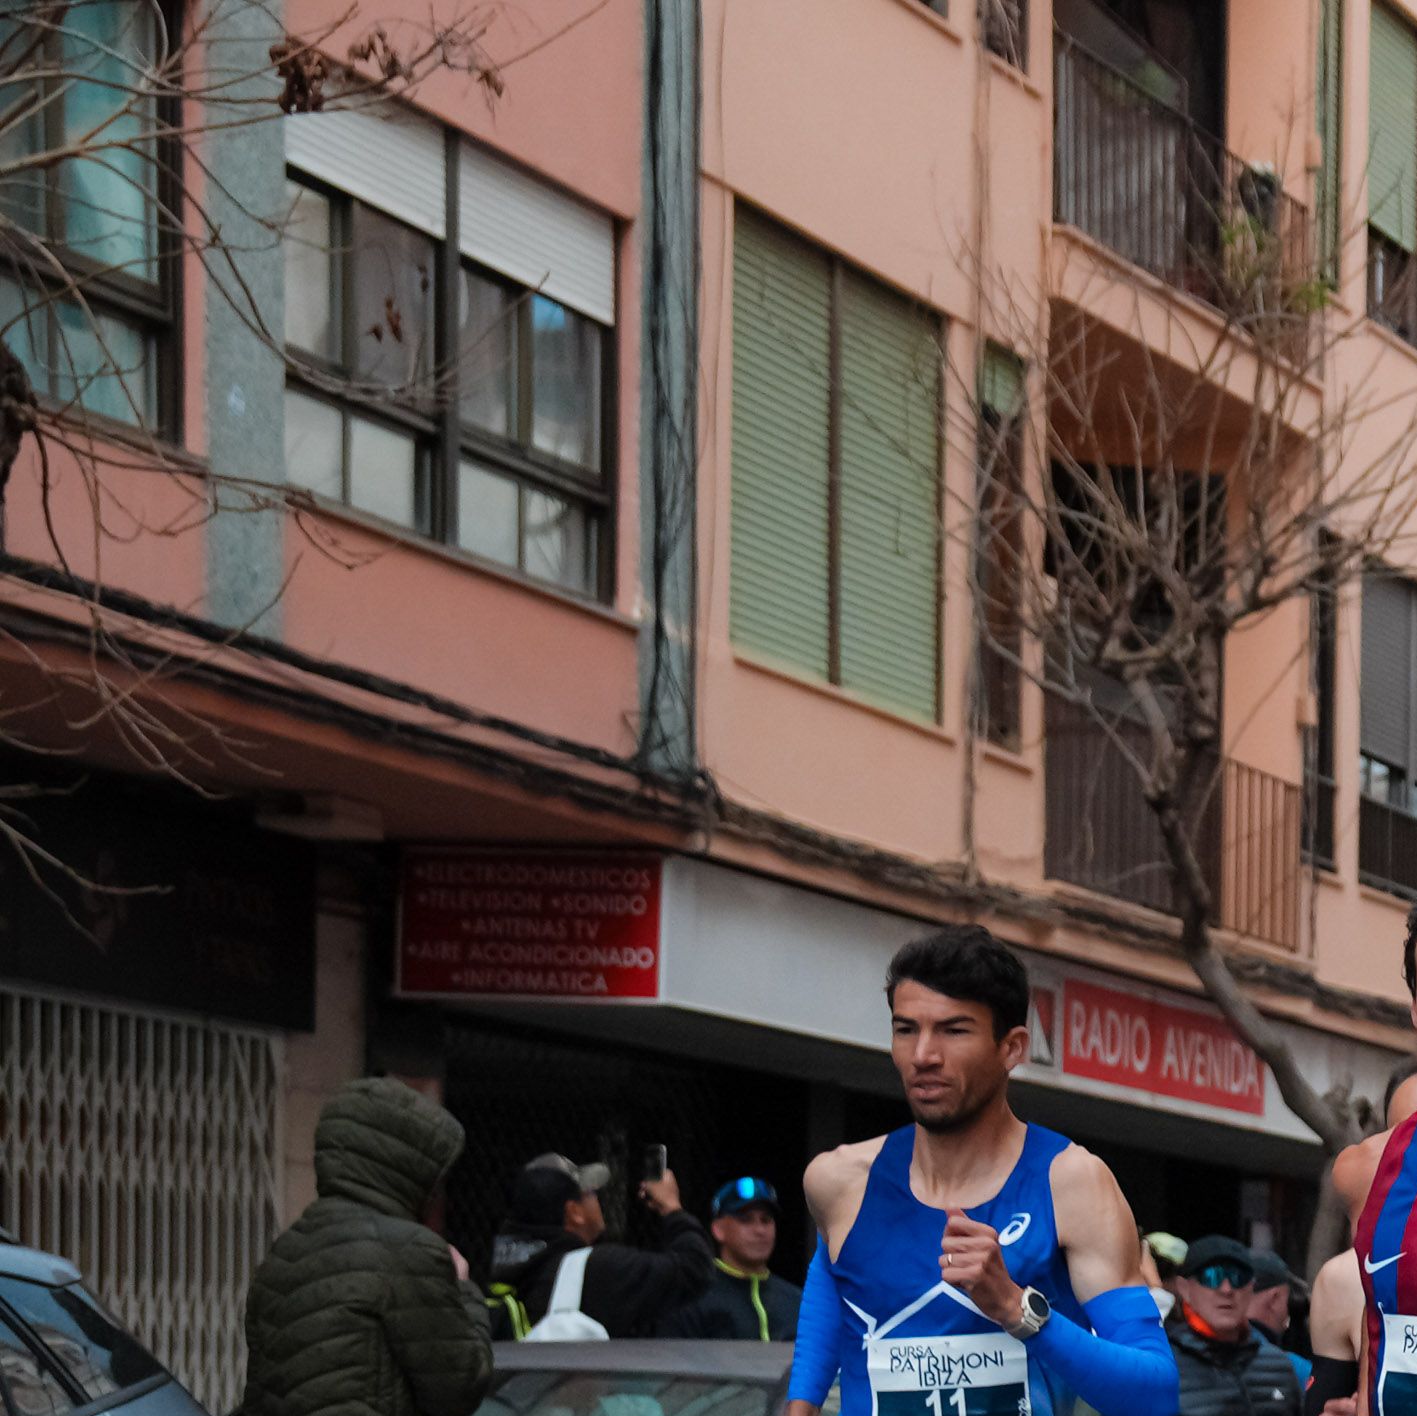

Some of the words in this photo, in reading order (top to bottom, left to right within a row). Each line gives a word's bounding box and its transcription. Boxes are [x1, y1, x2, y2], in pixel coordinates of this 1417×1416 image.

[427, 864, 651, 890] ELECTRODOMESTICOS
[429, 889, 542, 910] TELEVISION
[563, 894, 648, 916] SONIDO
[473, 916, 568, 937] ANTENAS
[574, 919, 600, 939] TV
[420, 940, 462, 960] AIRE
[468, 944, 655, 969] ACONDICIONADO
[464, 968, 608, 992] INFORMATICA
[1070, 1001, 1150, 1073] RADIO
[1161, 1026, 1263, 1097] AVENIDA
[890, 1345, 936, 1359] CURSA
[890, 1350, 1004, 1374] PATRIMONI
[919, 1369, 972, 1387] IBIZA
